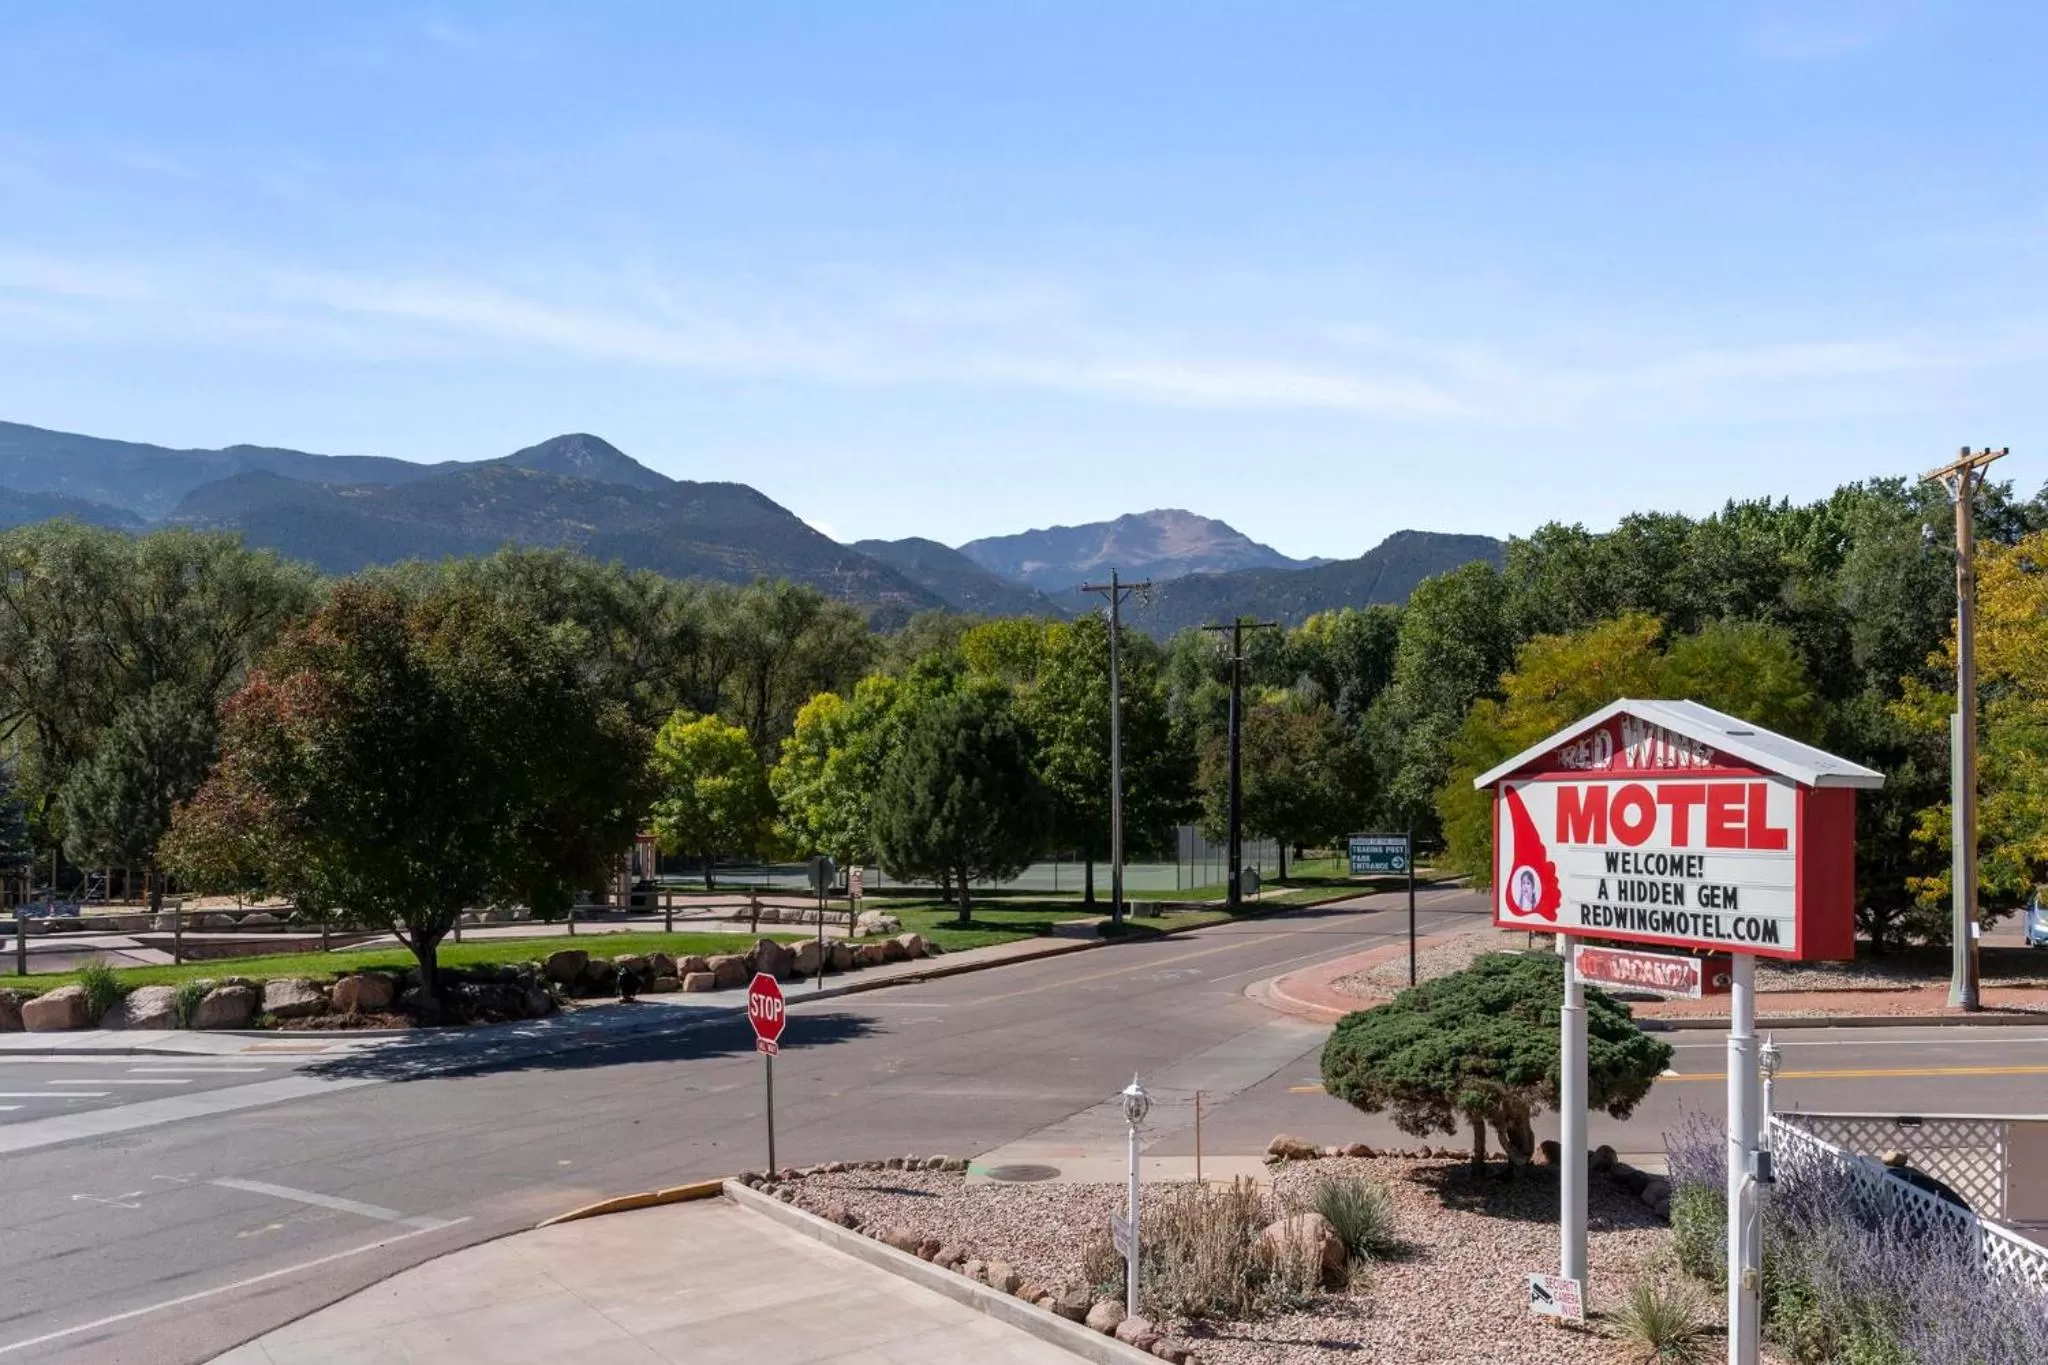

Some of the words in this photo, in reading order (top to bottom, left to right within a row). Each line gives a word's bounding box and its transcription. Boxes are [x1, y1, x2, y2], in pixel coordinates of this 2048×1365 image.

[1560, 728, 1613, 768] RED
[1621, 715, 1711, 769] WING
[1556, 783, 1788, 850] MOTEL
[1386, 845, 1404, 853] POST
[1604, 851, 1704, 878] WELCOME!
[1598, 878, 1609, 901] A
[1617, 879, 1685, 906] HIDDEN
[1698, 884, 1738, 910] GEM
[1580, 903, 1780, 944] REDWINGMOTEL.COM
[1611, 955, 1689, 987] VACANCY
[750, 992, 782, 1022] STOP
